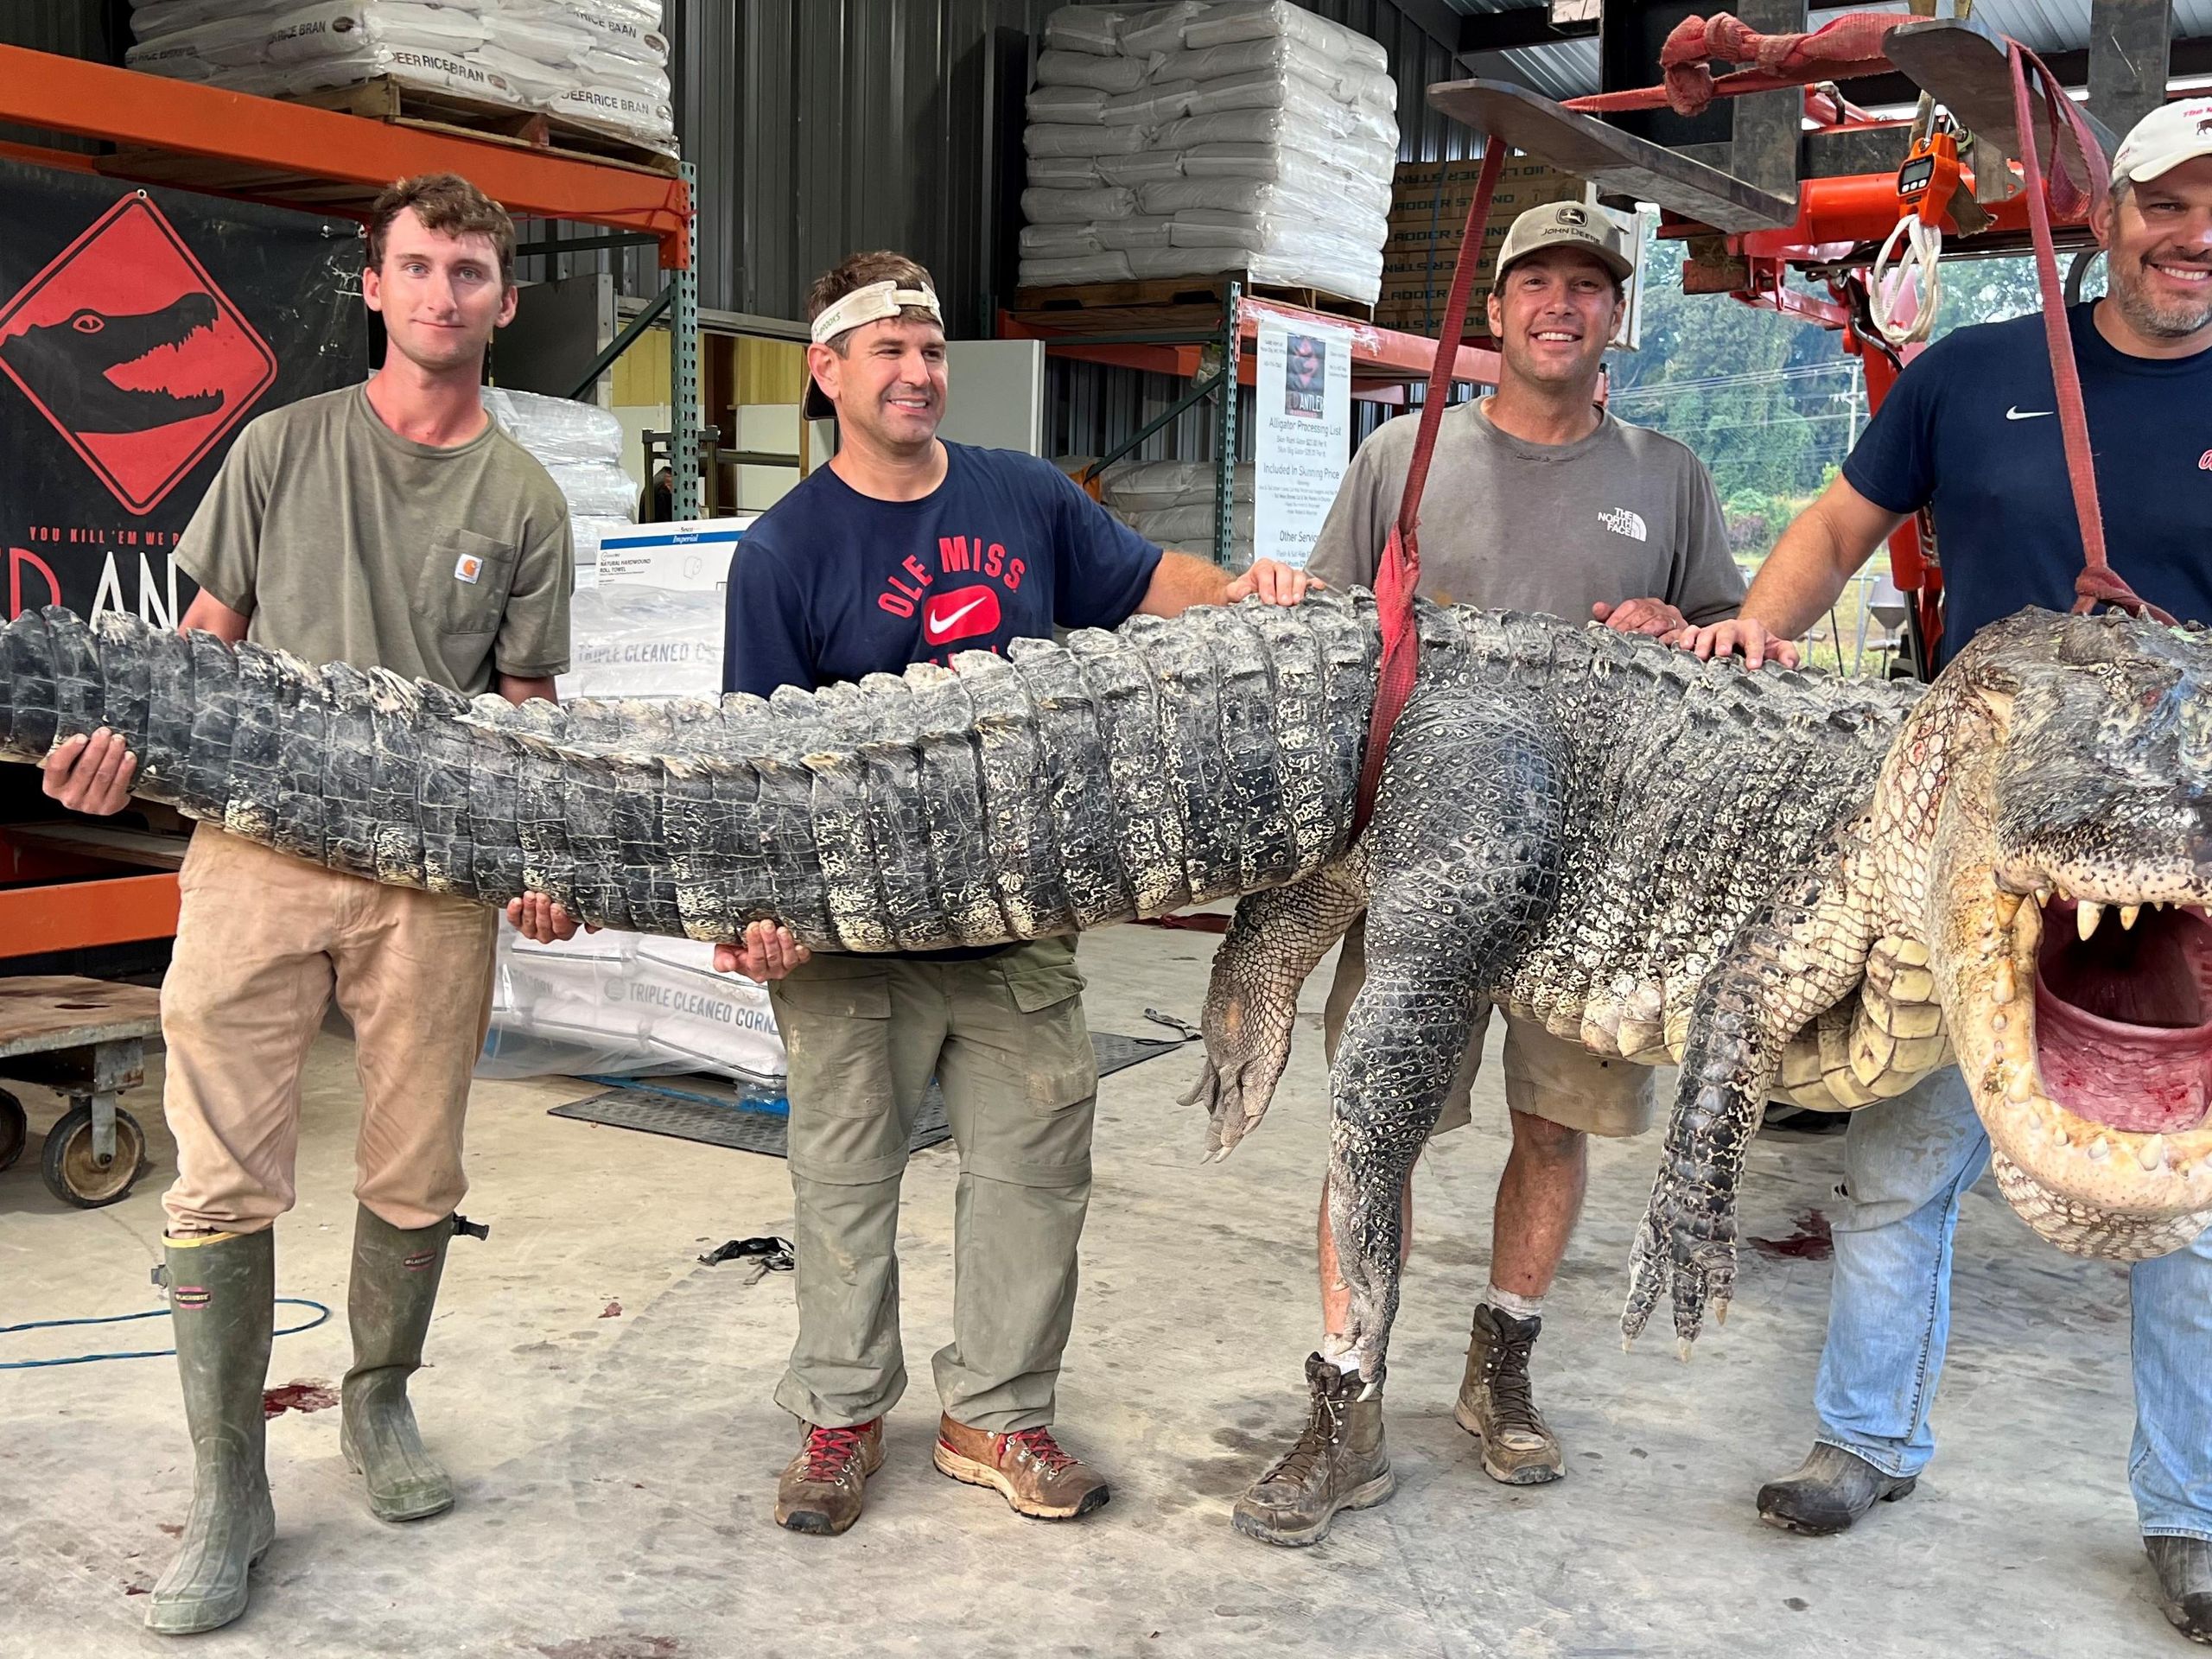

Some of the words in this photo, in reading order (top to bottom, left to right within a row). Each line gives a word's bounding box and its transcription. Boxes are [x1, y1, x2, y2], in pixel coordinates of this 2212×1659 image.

[299, 21, 327, 35] BRAN
[423, 54, 450, 72] RICE
[449, 62, 484, 82] BRAN
[594, 93, 619, 109] RICE
[620, 99, 650, 115] BRAN
[1268, 417, 1296, 432] Alligator
[1297, 420, 1329, 437] Processing
[1330, 424, 1341, 436] List
[1263, 462, 1290, 475] Included
[1291, 465, 1297, 475] In
[1299, 466, 1323, 480] Skinning
[1324, 467, 1339, 480] Price
[1598, 512, 1632, 528] NORTH
[1614, 506, 1633, 520] THE
[29, 525, 61, 543] YOU
[70, 527, 105, 544] KILL
[111, 530, 137, 545] 'EM
[145, 531, 164, 546] WE
[1279, 530, 1297, 543] Other
[1607, 521, 1631, 537] FACE
[672, 533, 699, 545] Imperial
[878, 554, 934, 619] OLE
[938, 535, 1026, 590] MISS
[625, 643, 690, 664] CLEANED
[630, 982, 672, 1008] TRIPLE
[673, 990, 733, 1024] CLEANED
[735, 1007, 775, 1033] CORN
